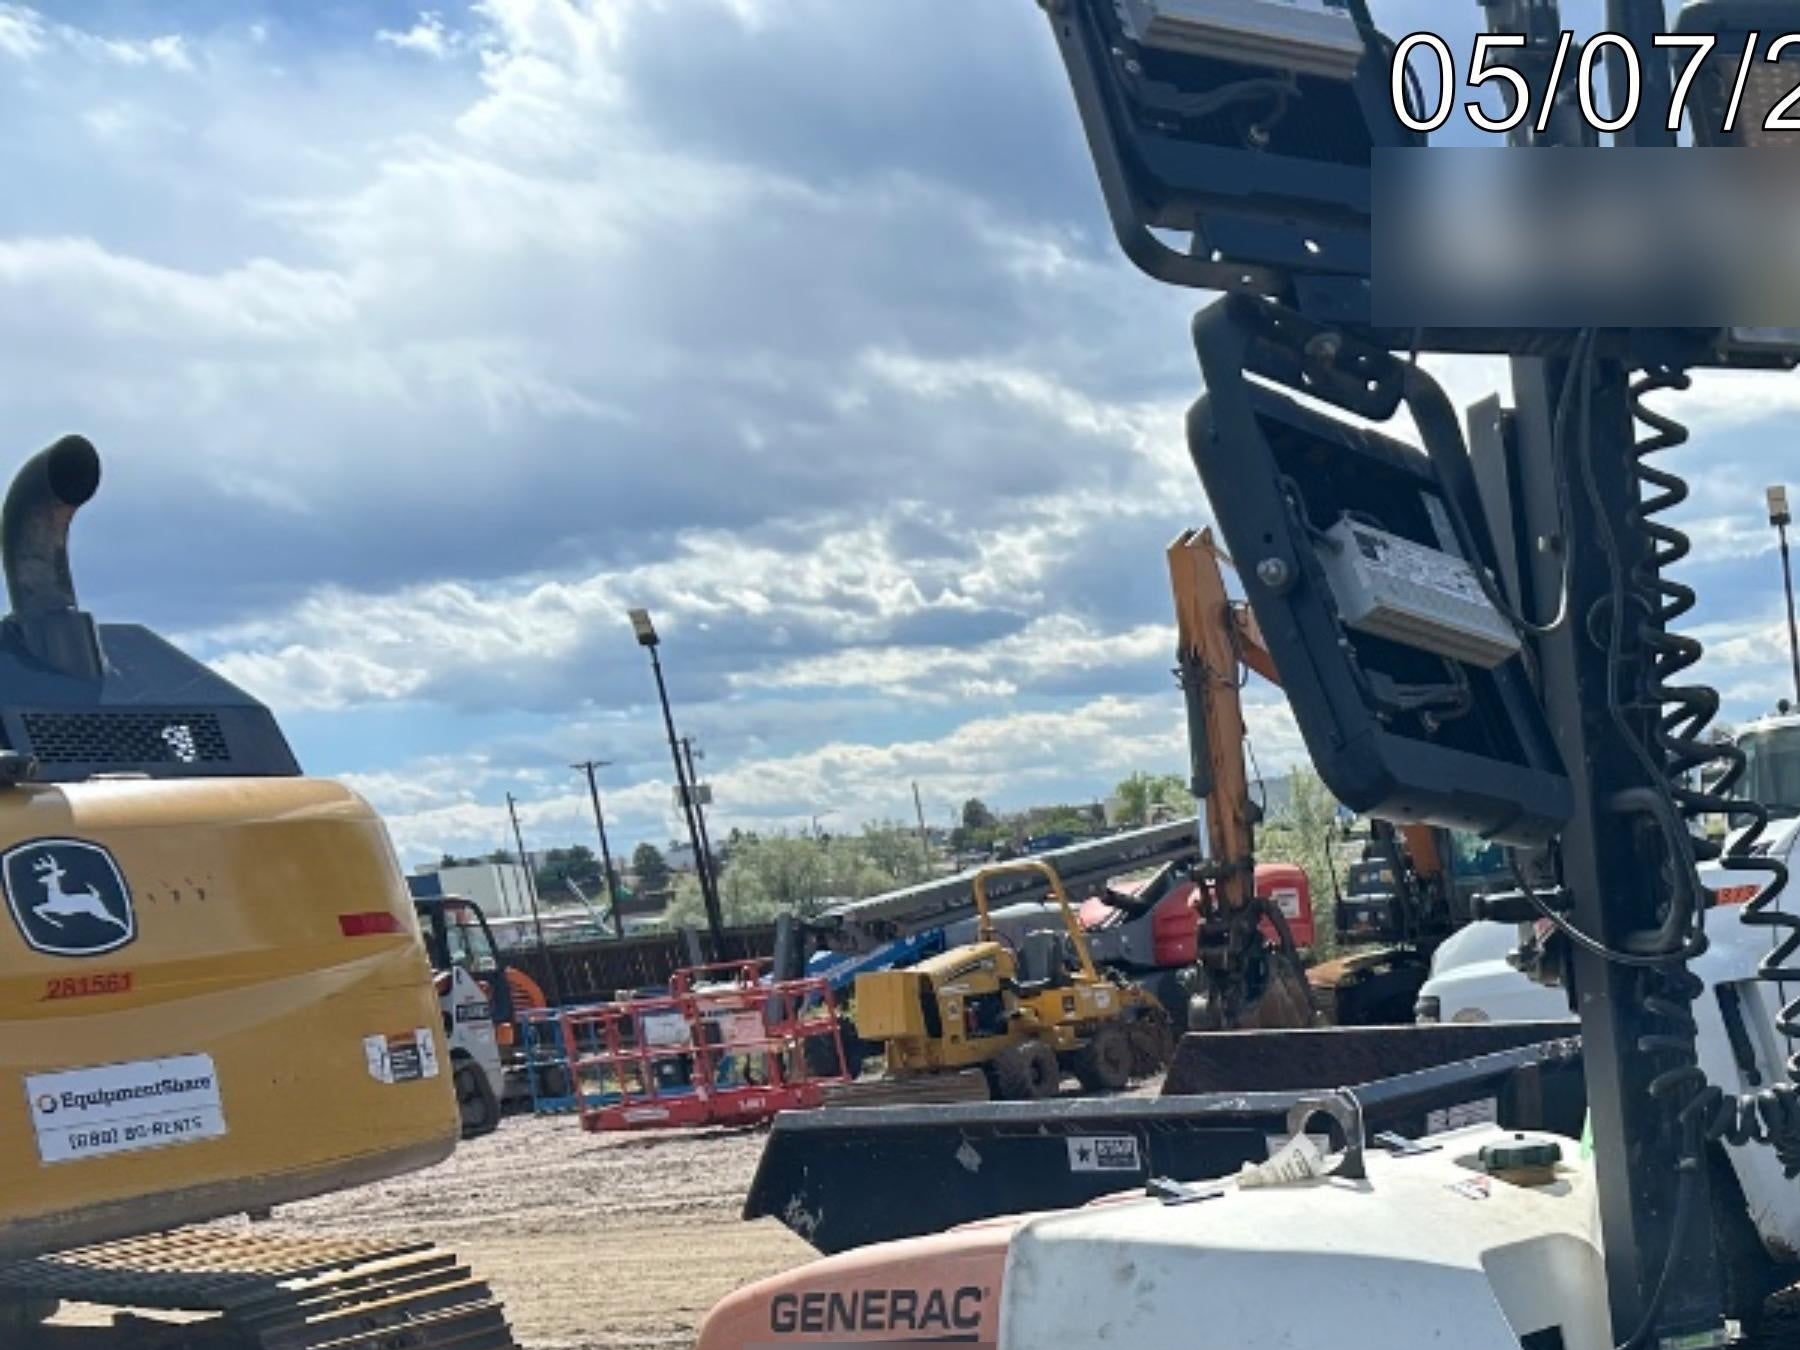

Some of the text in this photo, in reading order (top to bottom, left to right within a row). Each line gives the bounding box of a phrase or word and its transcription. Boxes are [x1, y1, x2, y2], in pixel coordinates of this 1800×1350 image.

[46, 972, 133, 999] 281561
[60, 1076, 211, 1111] EquipmentShare
[770, 1286, 983, 1333] GENERAC
